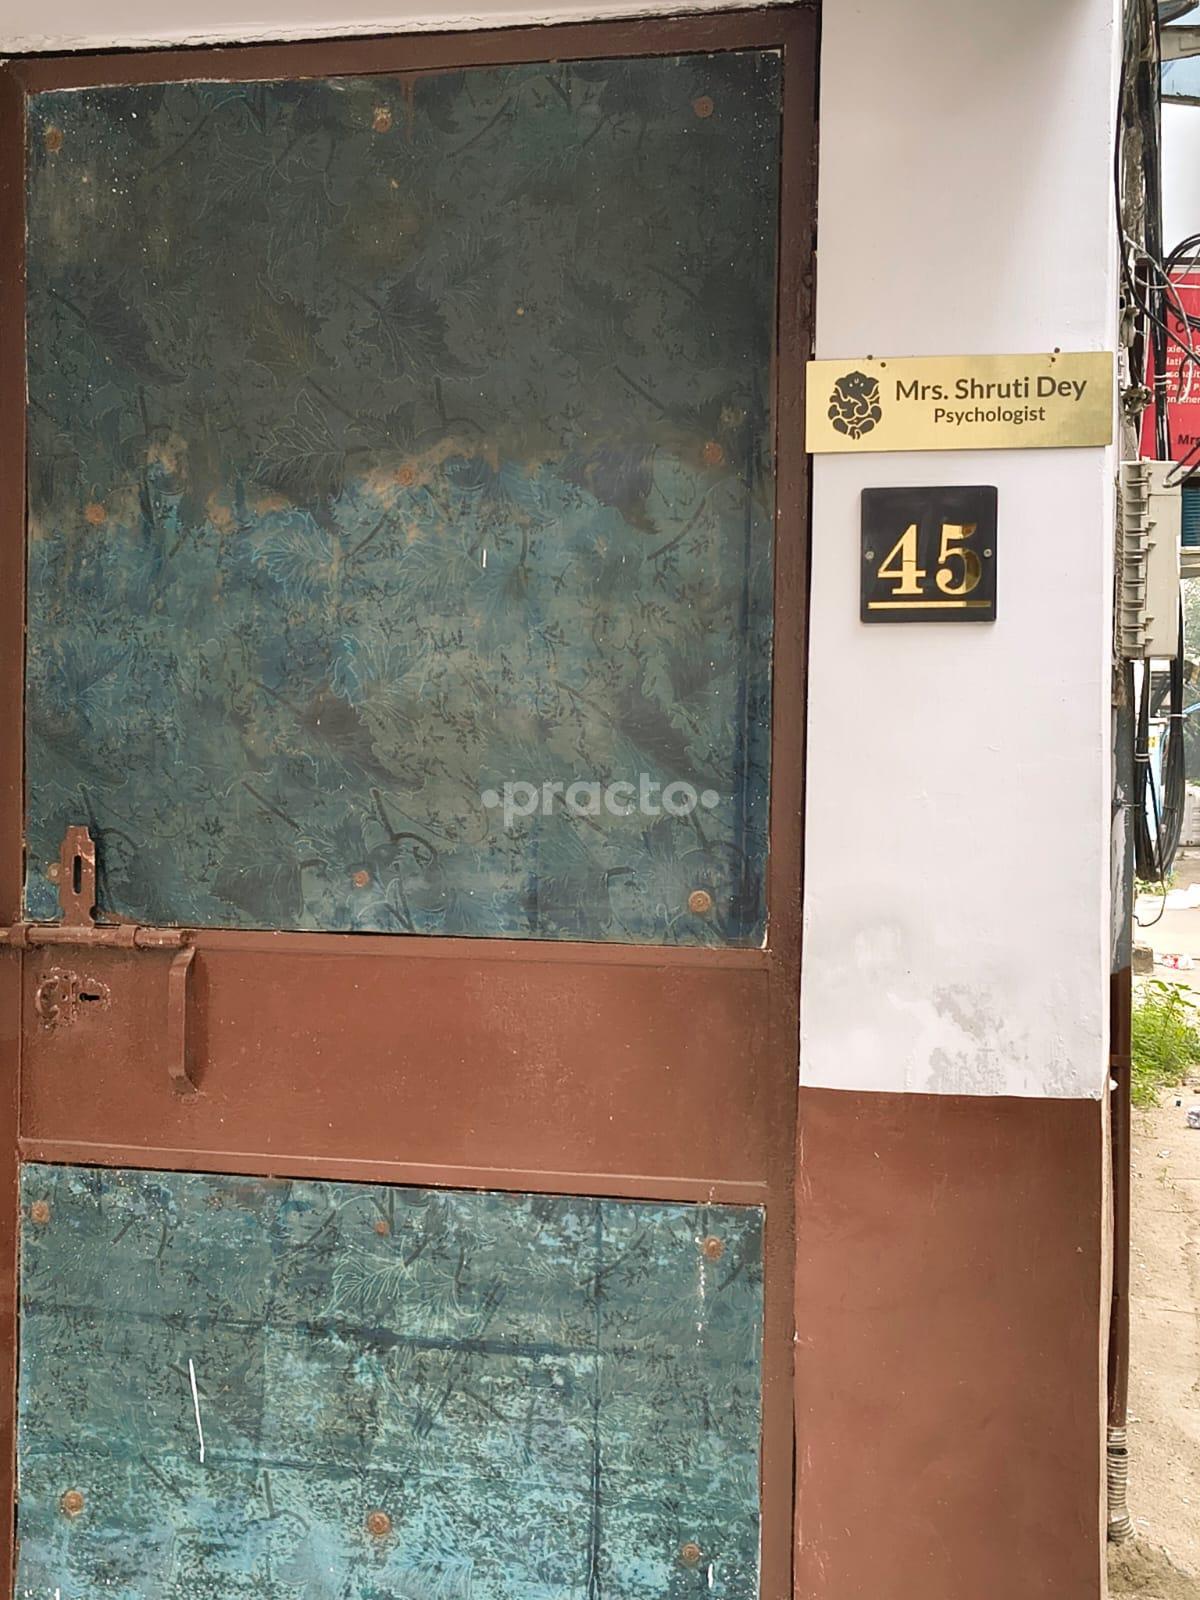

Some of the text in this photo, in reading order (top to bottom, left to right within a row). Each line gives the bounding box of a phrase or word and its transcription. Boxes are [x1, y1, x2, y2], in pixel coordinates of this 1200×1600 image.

[896, 376, 1087, 401] Mrs. Shruti Dey
[934, 405, 1046, 425] Psychologist
[877, 524, 982, 595] 45
